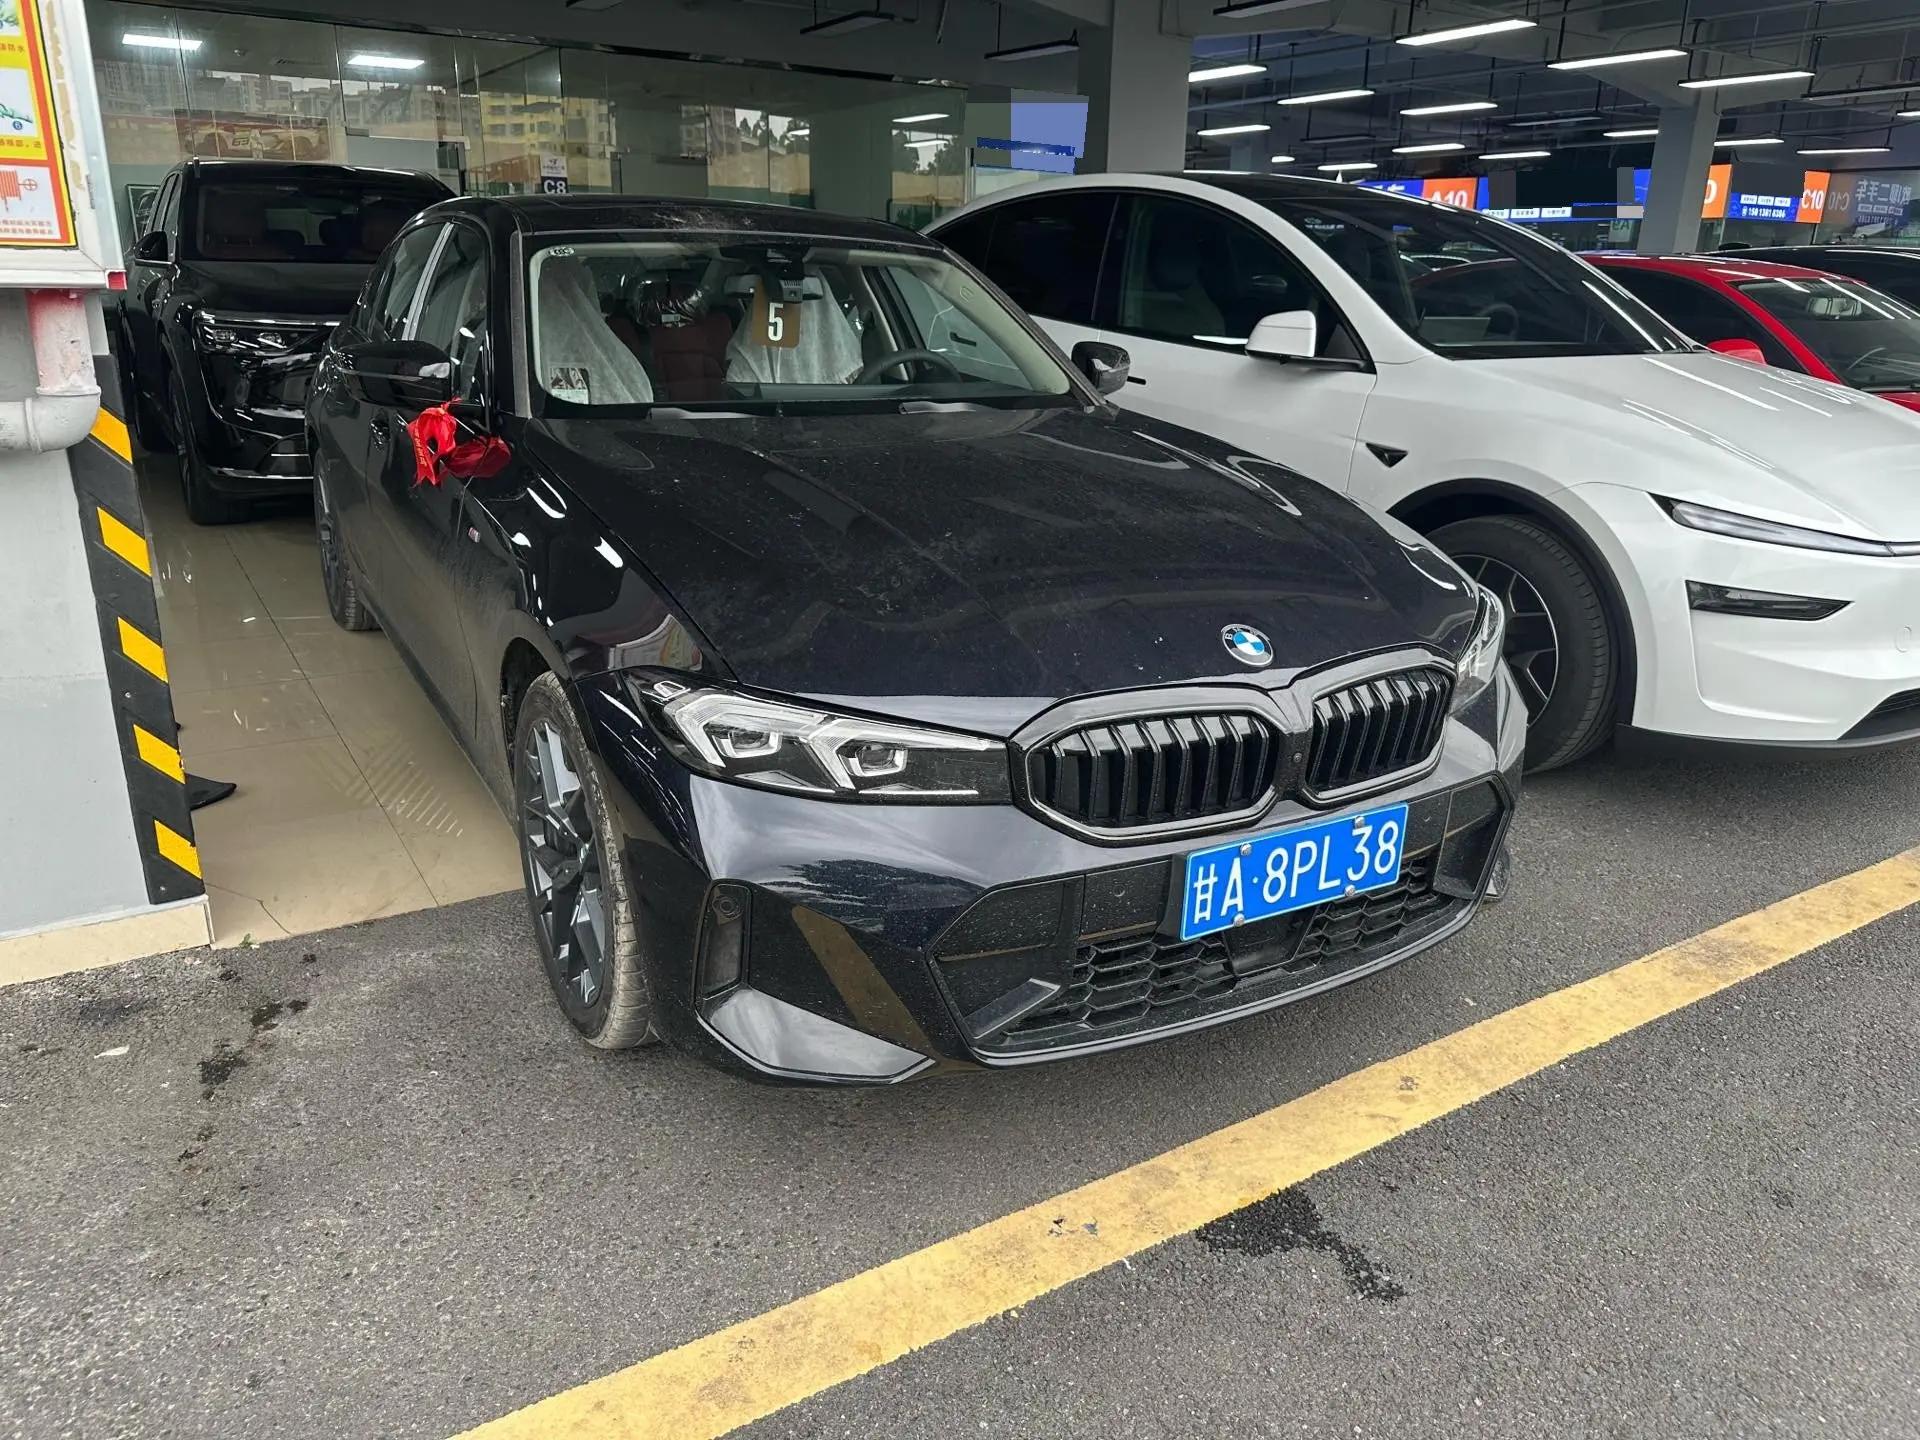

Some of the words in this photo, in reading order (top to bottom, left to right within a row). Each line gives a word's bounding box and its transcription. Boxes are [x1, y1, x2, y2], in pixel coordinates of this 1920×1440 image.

[543, 179, 566, 194] C8
[1801, 189, 1825, 210] C10
[767, 302, 785, 341] 5
